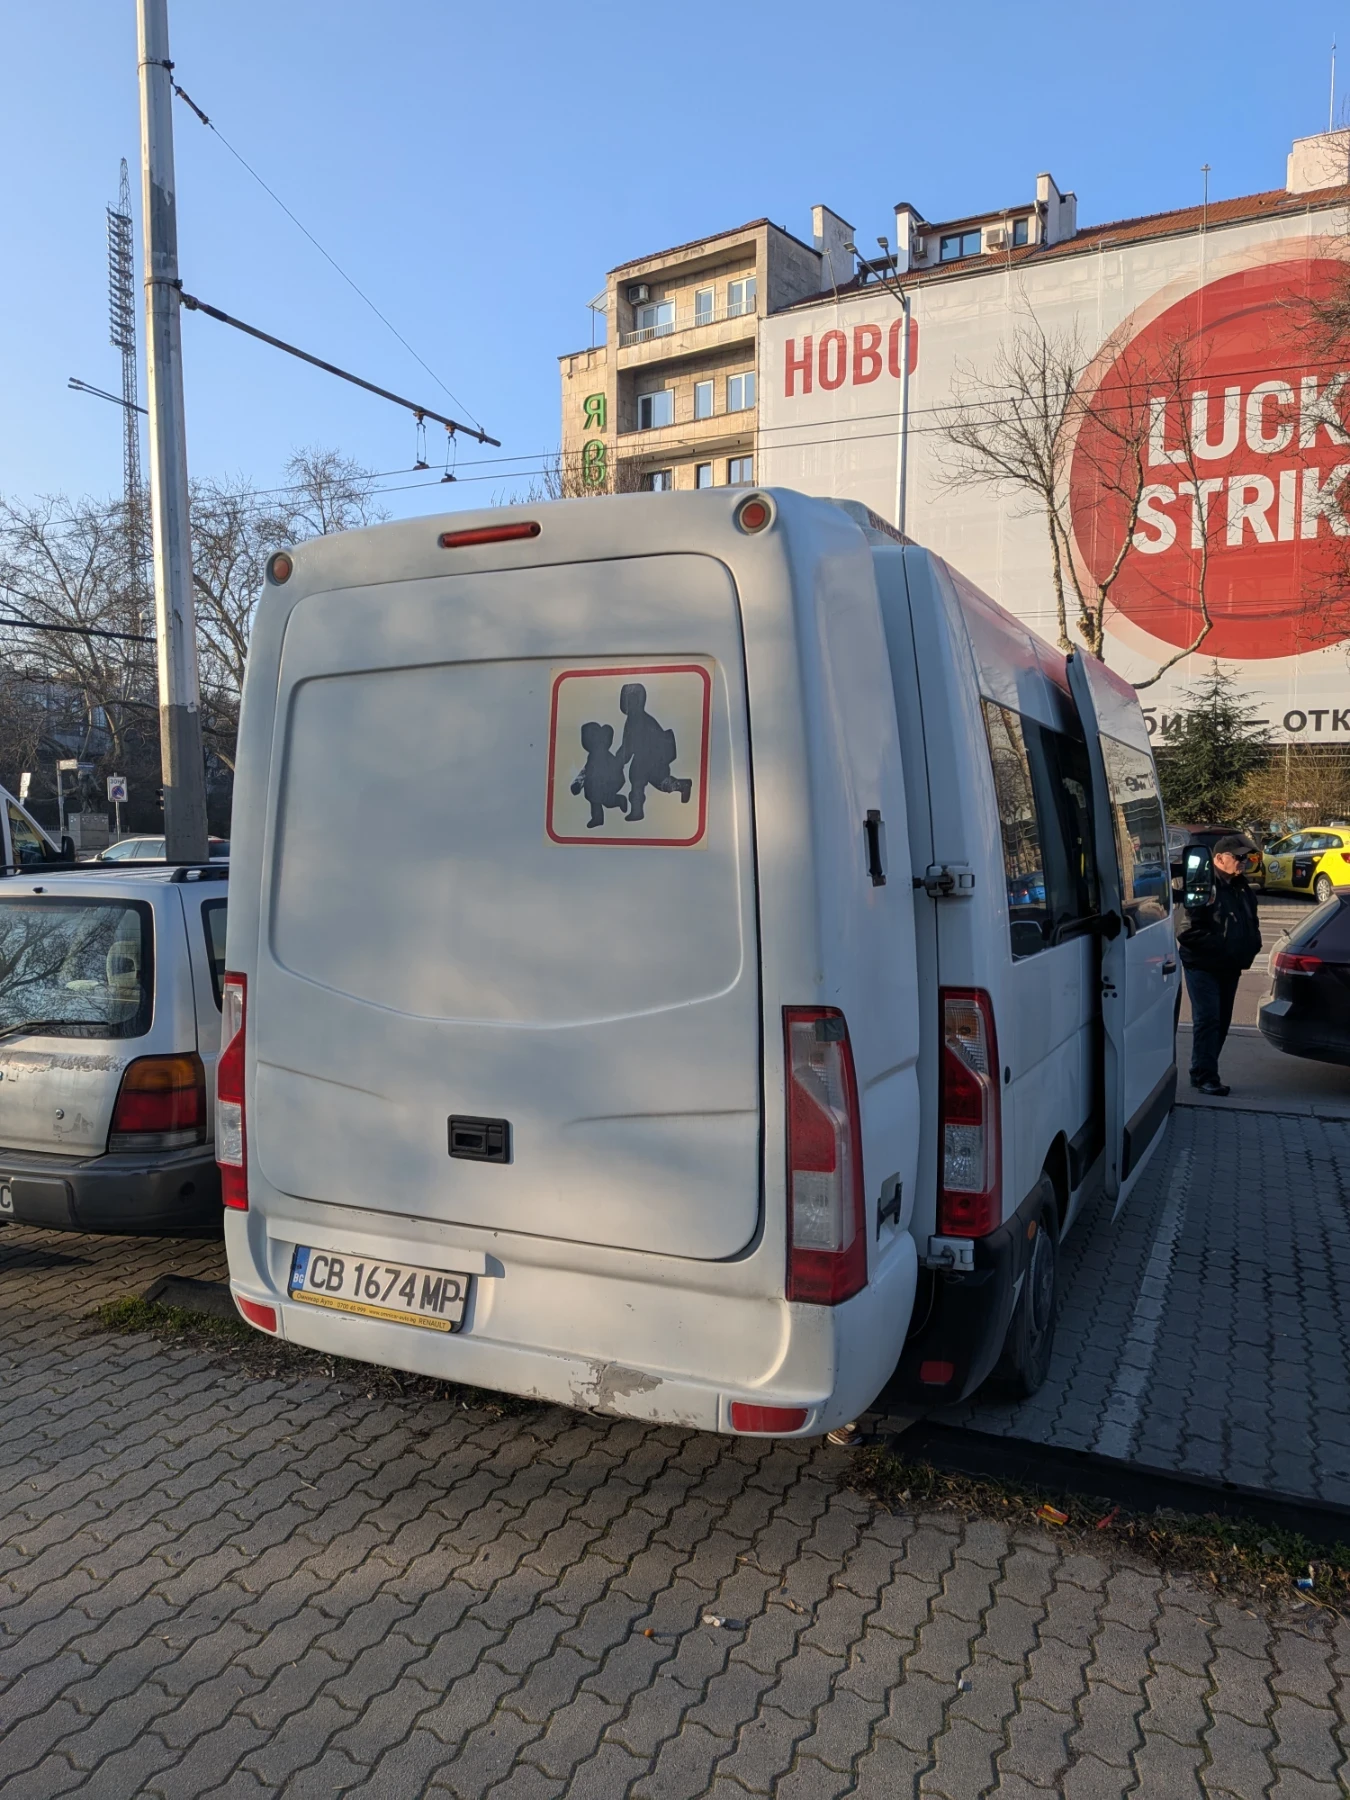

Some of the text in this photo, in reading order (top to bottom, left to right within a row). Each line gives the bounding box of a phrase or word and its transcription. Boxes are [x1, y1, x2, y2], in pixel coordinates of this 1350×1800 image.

[785, 317, 919, 398] НОВО
[1148, 371, 1350, 467] LUCK
[1132, 464, 1350, 554] STRIK
[292, 1272, 305, 1284] BG
[309, 1255, 461, 1313] CB 1674 MP
[418, 1317, 446, 1329] RENAULT
